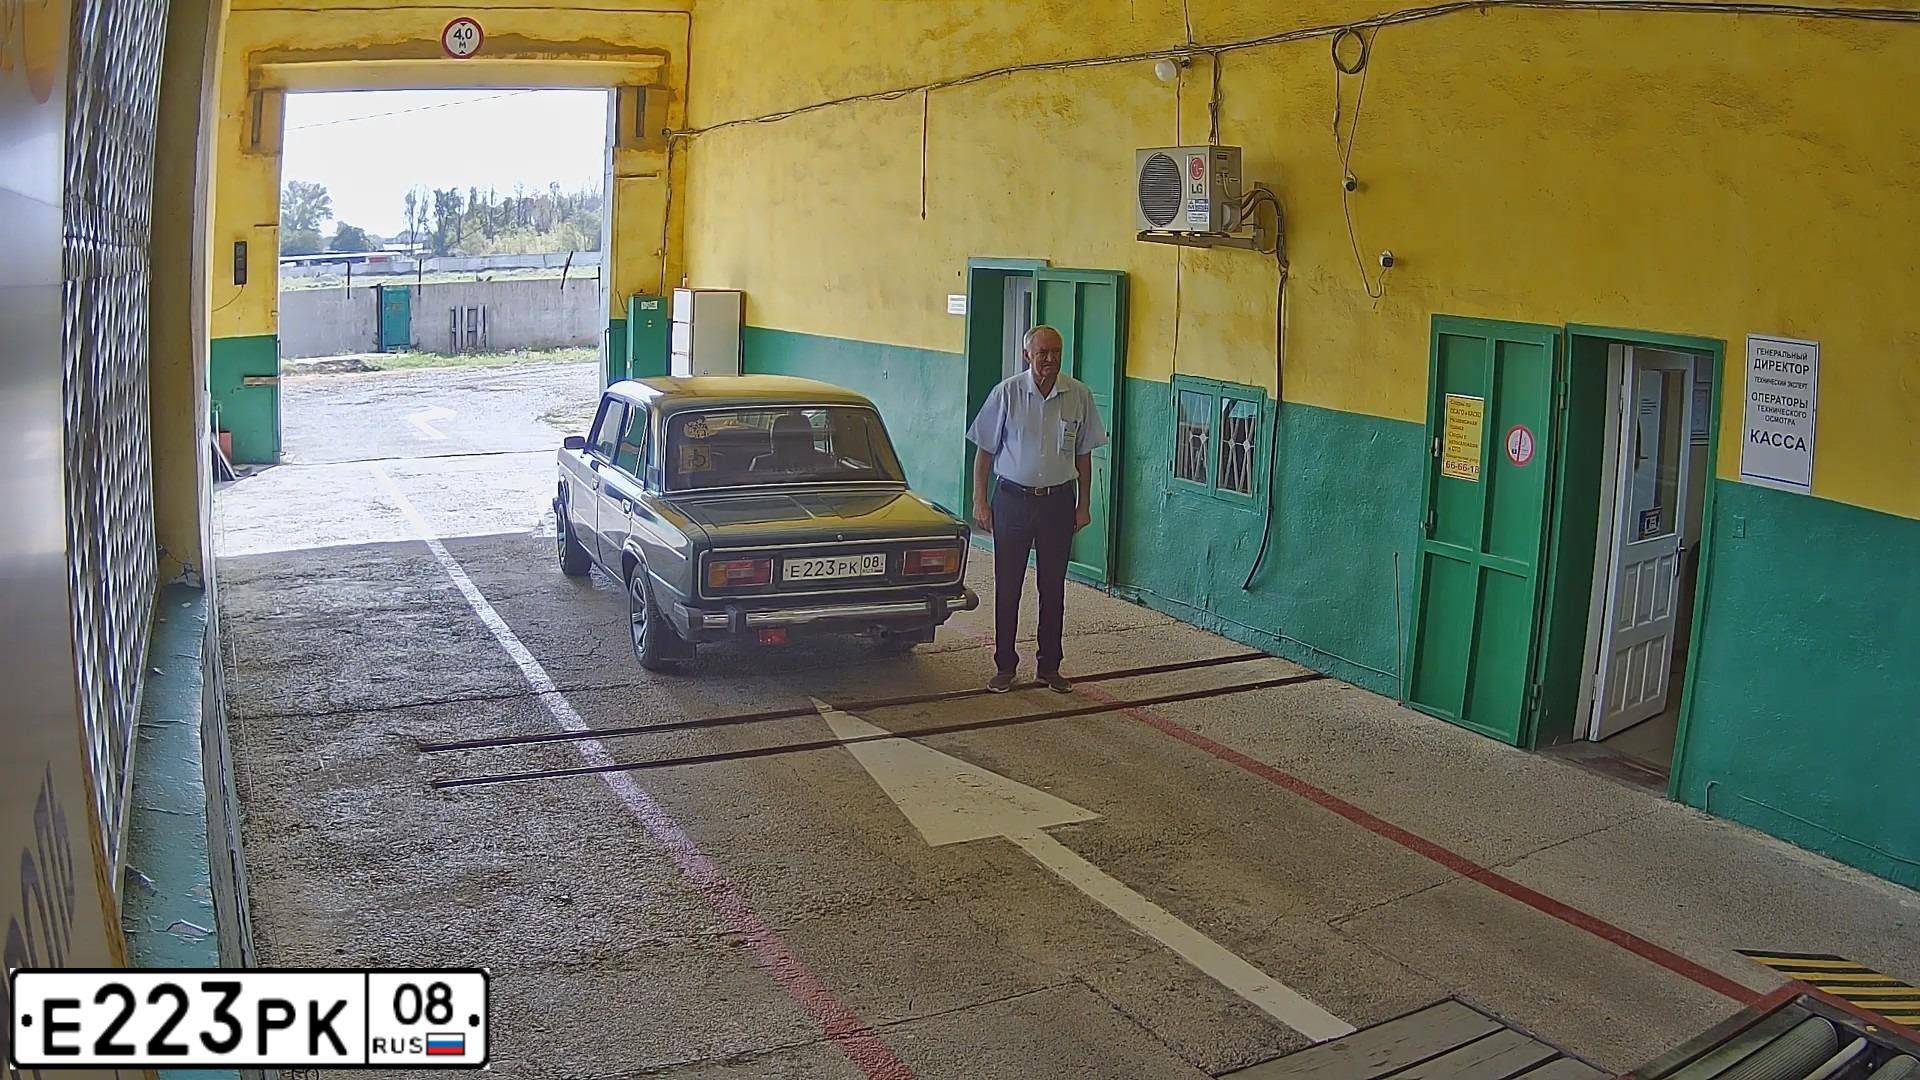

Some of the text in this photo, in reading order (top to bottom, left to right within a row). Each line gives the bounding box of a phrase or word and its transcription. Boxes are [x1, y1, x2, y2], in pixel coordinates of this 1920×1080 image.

[453, 28, 473, 41] 4,0
[1192, 184, 1203, 194] LG
[1756, 347, 1808, 360] ГЕНЕРАЛЬНЫЙ
[1753, 358, 1809, 375] ДИРЕКТОР
[1751, 392, 1808, 408] ОПЕРАТОРЫ
[1757, 405, 1807, 419] ТЕХНИЧЕСКОГО
[1765, 415, 1796, 426] ОСМОТРА
[1750, 429, 1807, 452] КАССА
[864, 556, 879, 568] 08
